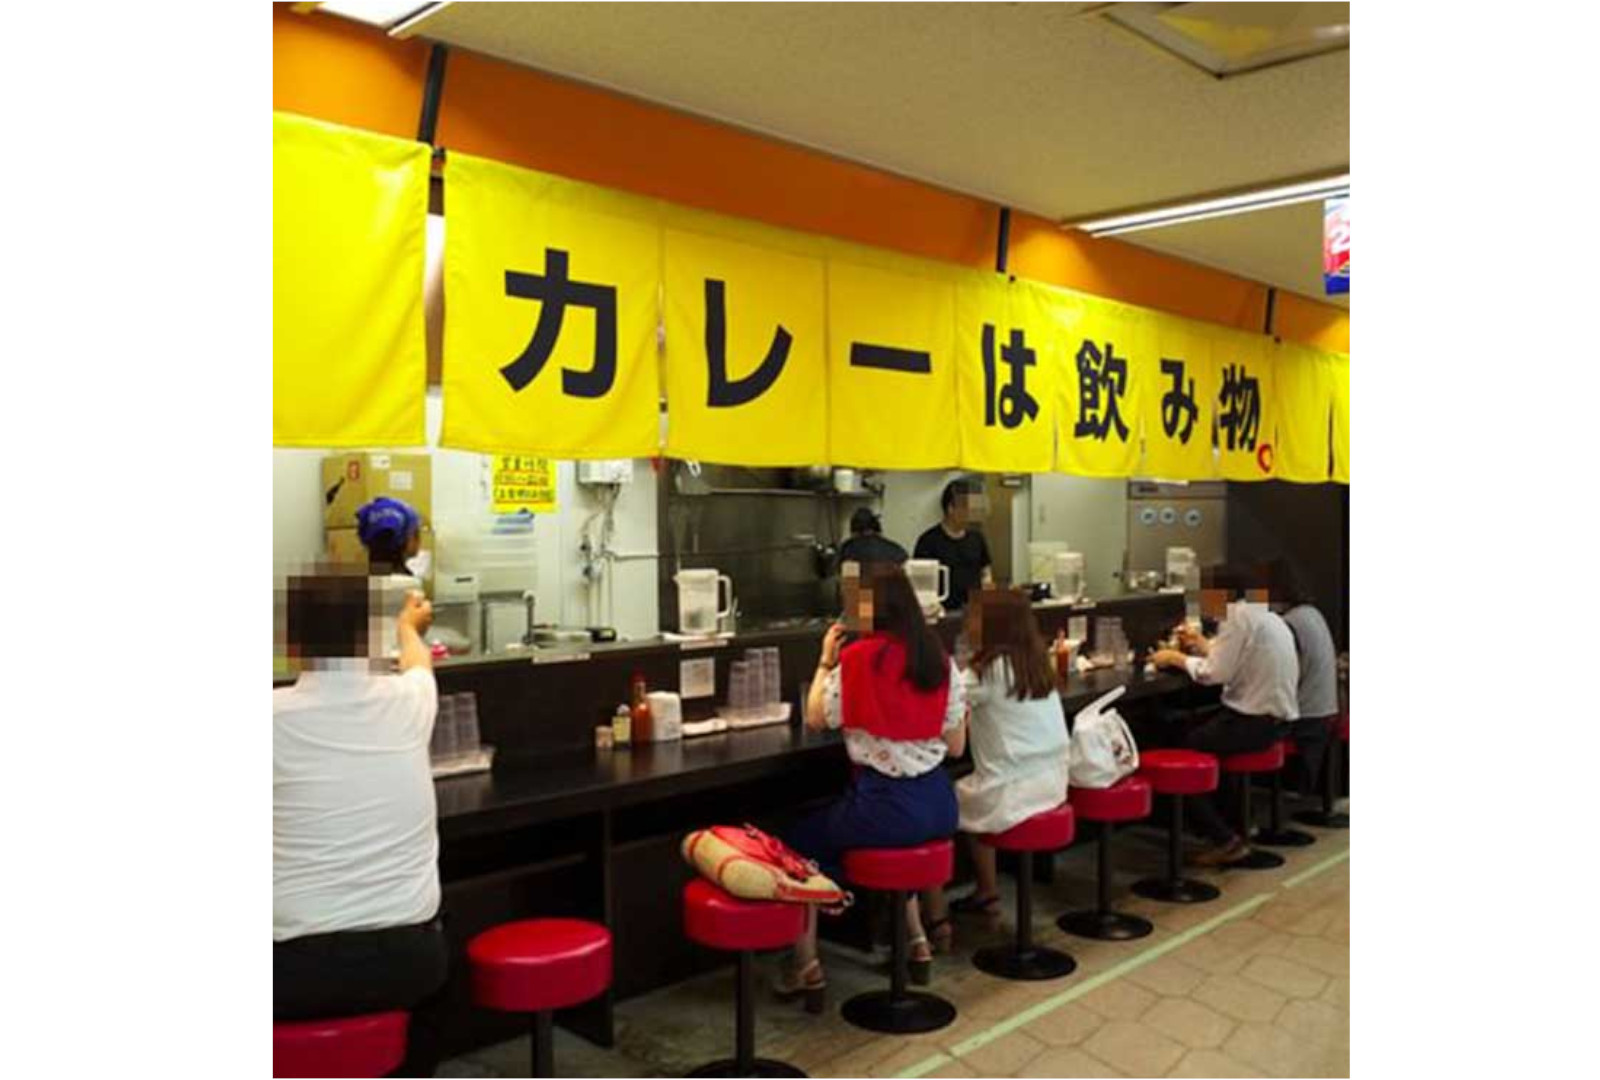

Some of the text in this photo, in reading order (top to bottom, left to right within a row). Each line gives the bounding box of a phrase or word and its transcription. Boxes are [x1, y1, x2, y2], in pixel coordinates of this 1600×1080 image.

[499, 247, 1274, 474] カレーは飲み物。
